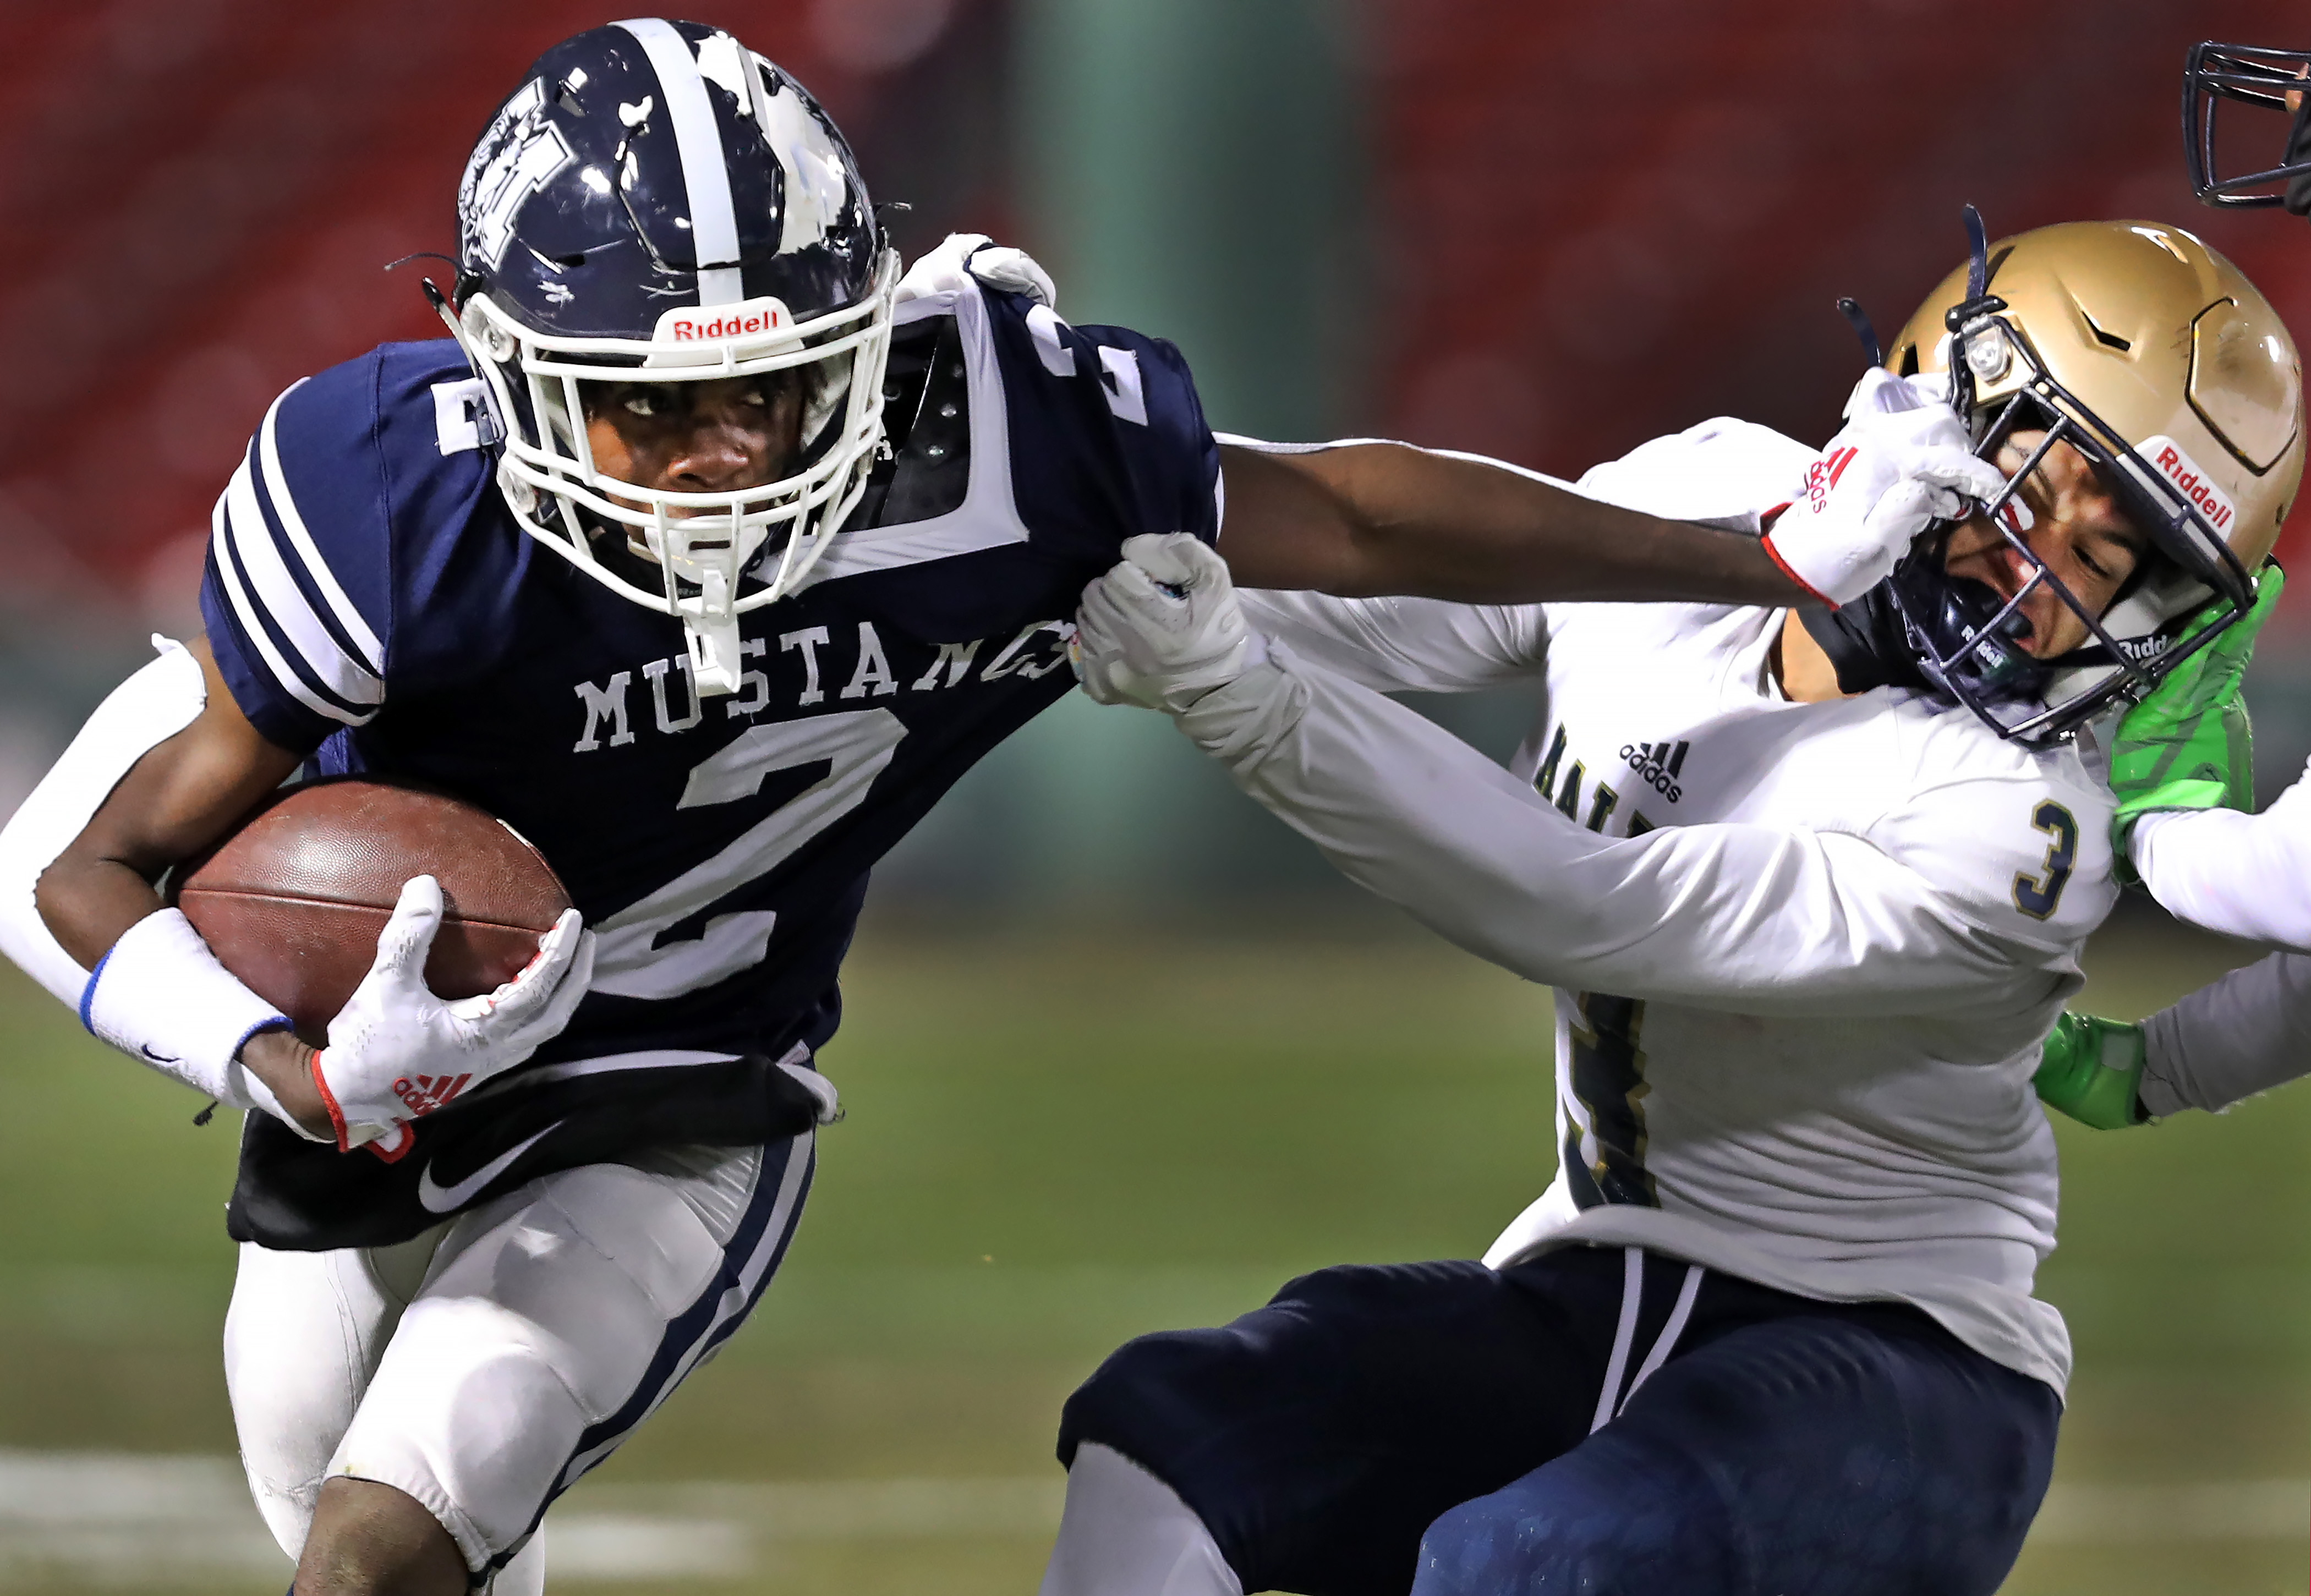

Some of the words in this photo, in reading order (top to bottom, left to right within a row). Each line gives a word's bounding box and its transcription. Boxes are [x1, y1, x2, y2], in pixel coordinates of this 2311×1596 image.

[674, 310, 777, 341] Riddell
[2156, 446, 2232, 529] Riddell
[1960, 624, 2005, 669] Rdell
[2118, 634, 2168, 661] Ridd
[1619, 744, 1683, 804] adidas
[590, 706, 910, 1001] 2
[2011, 798, 2079, 921] 3
